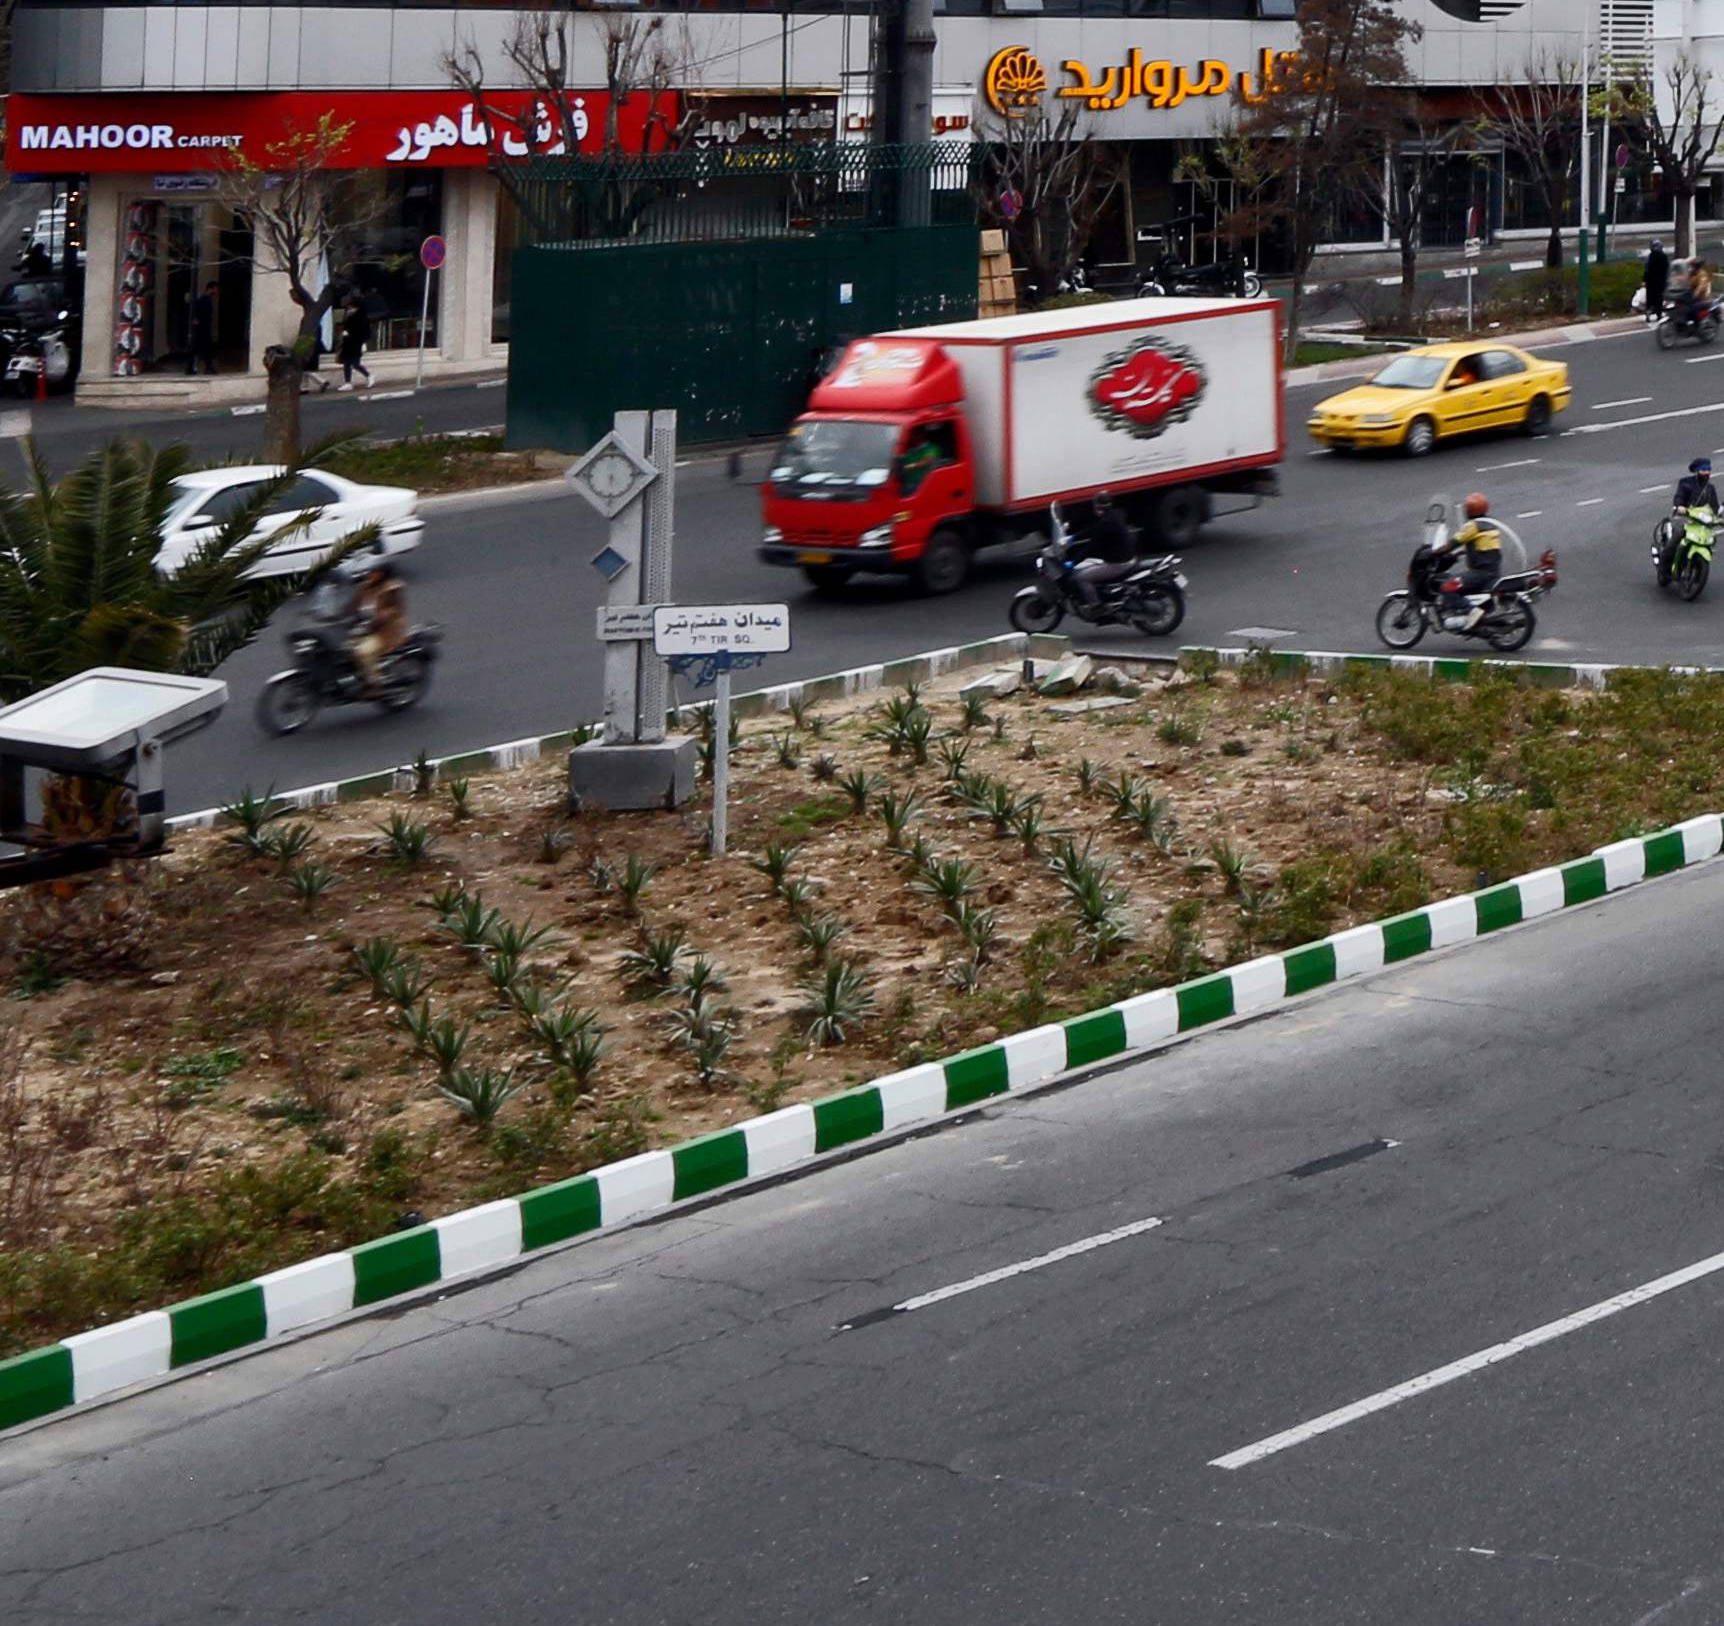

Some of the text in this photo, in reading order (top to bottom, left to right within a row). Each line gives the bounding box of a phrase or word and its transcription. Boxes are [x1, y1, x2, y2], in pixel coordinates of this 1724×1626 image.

[1056, 46, 1231, 110] مروارید
[20, 124, 244, 150] MAHOOR CARPET
[384, 102, 495, 161] ماهور
[662, 615, 689, 635] تیر
[734, 611, 782, 631] میدان
[710, 635, 728, 645] TIR
